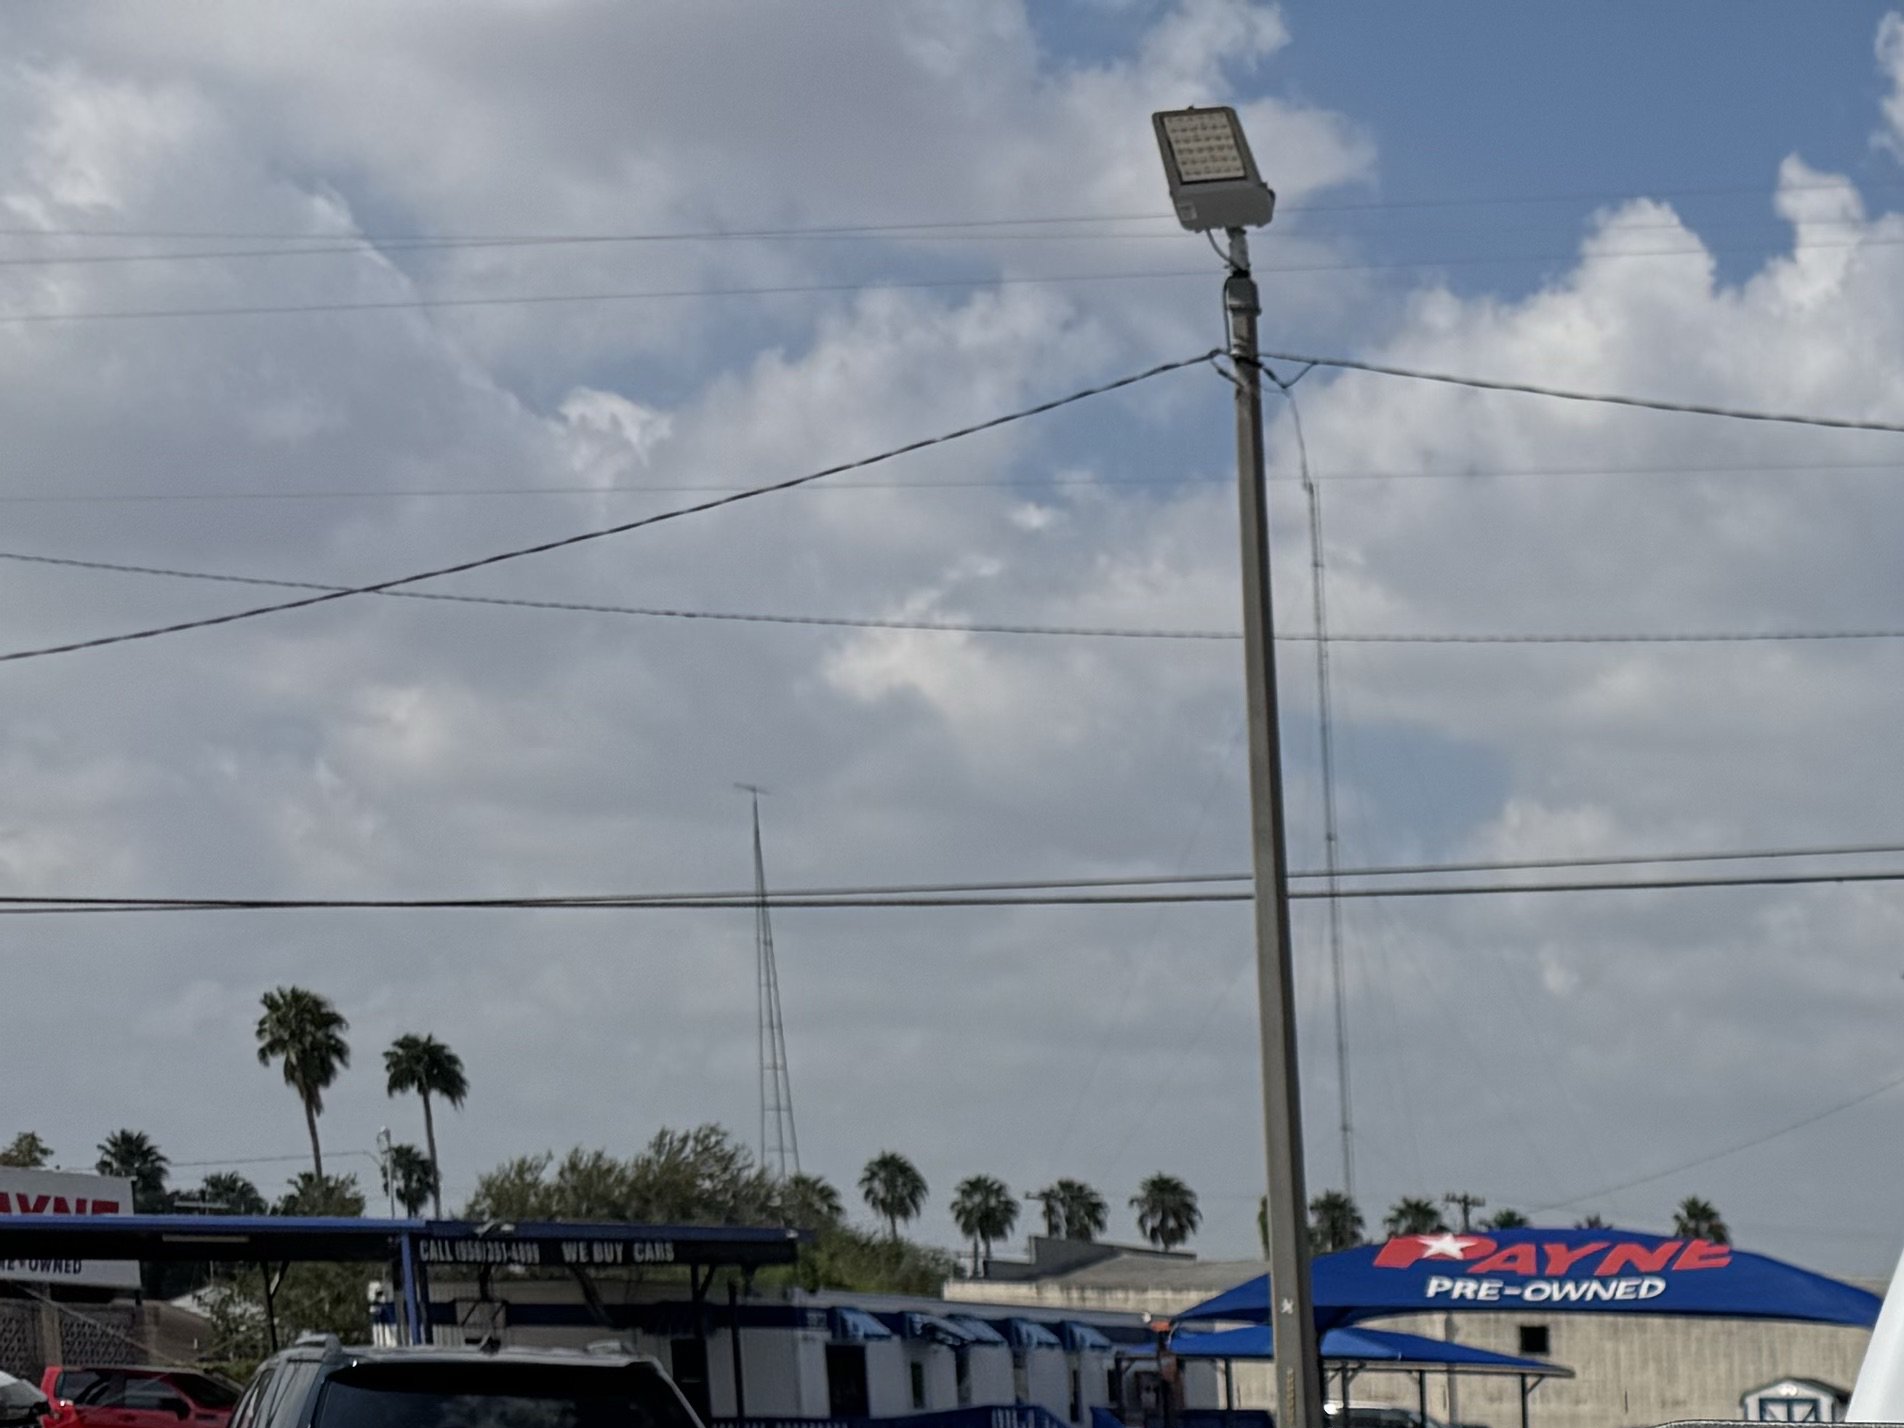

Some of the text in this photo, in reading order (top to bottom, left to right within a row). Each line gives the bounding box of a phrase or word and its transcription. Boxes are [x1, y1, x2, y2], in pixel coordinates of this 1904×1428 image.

[419, 1239, 453, 1262] CALL
[562, 1241, 589, 1263] WE
[1372, 1233, 1732, 1276] PAYNE
[1425, 1275, 1666, 1302] PRE-OWNED
